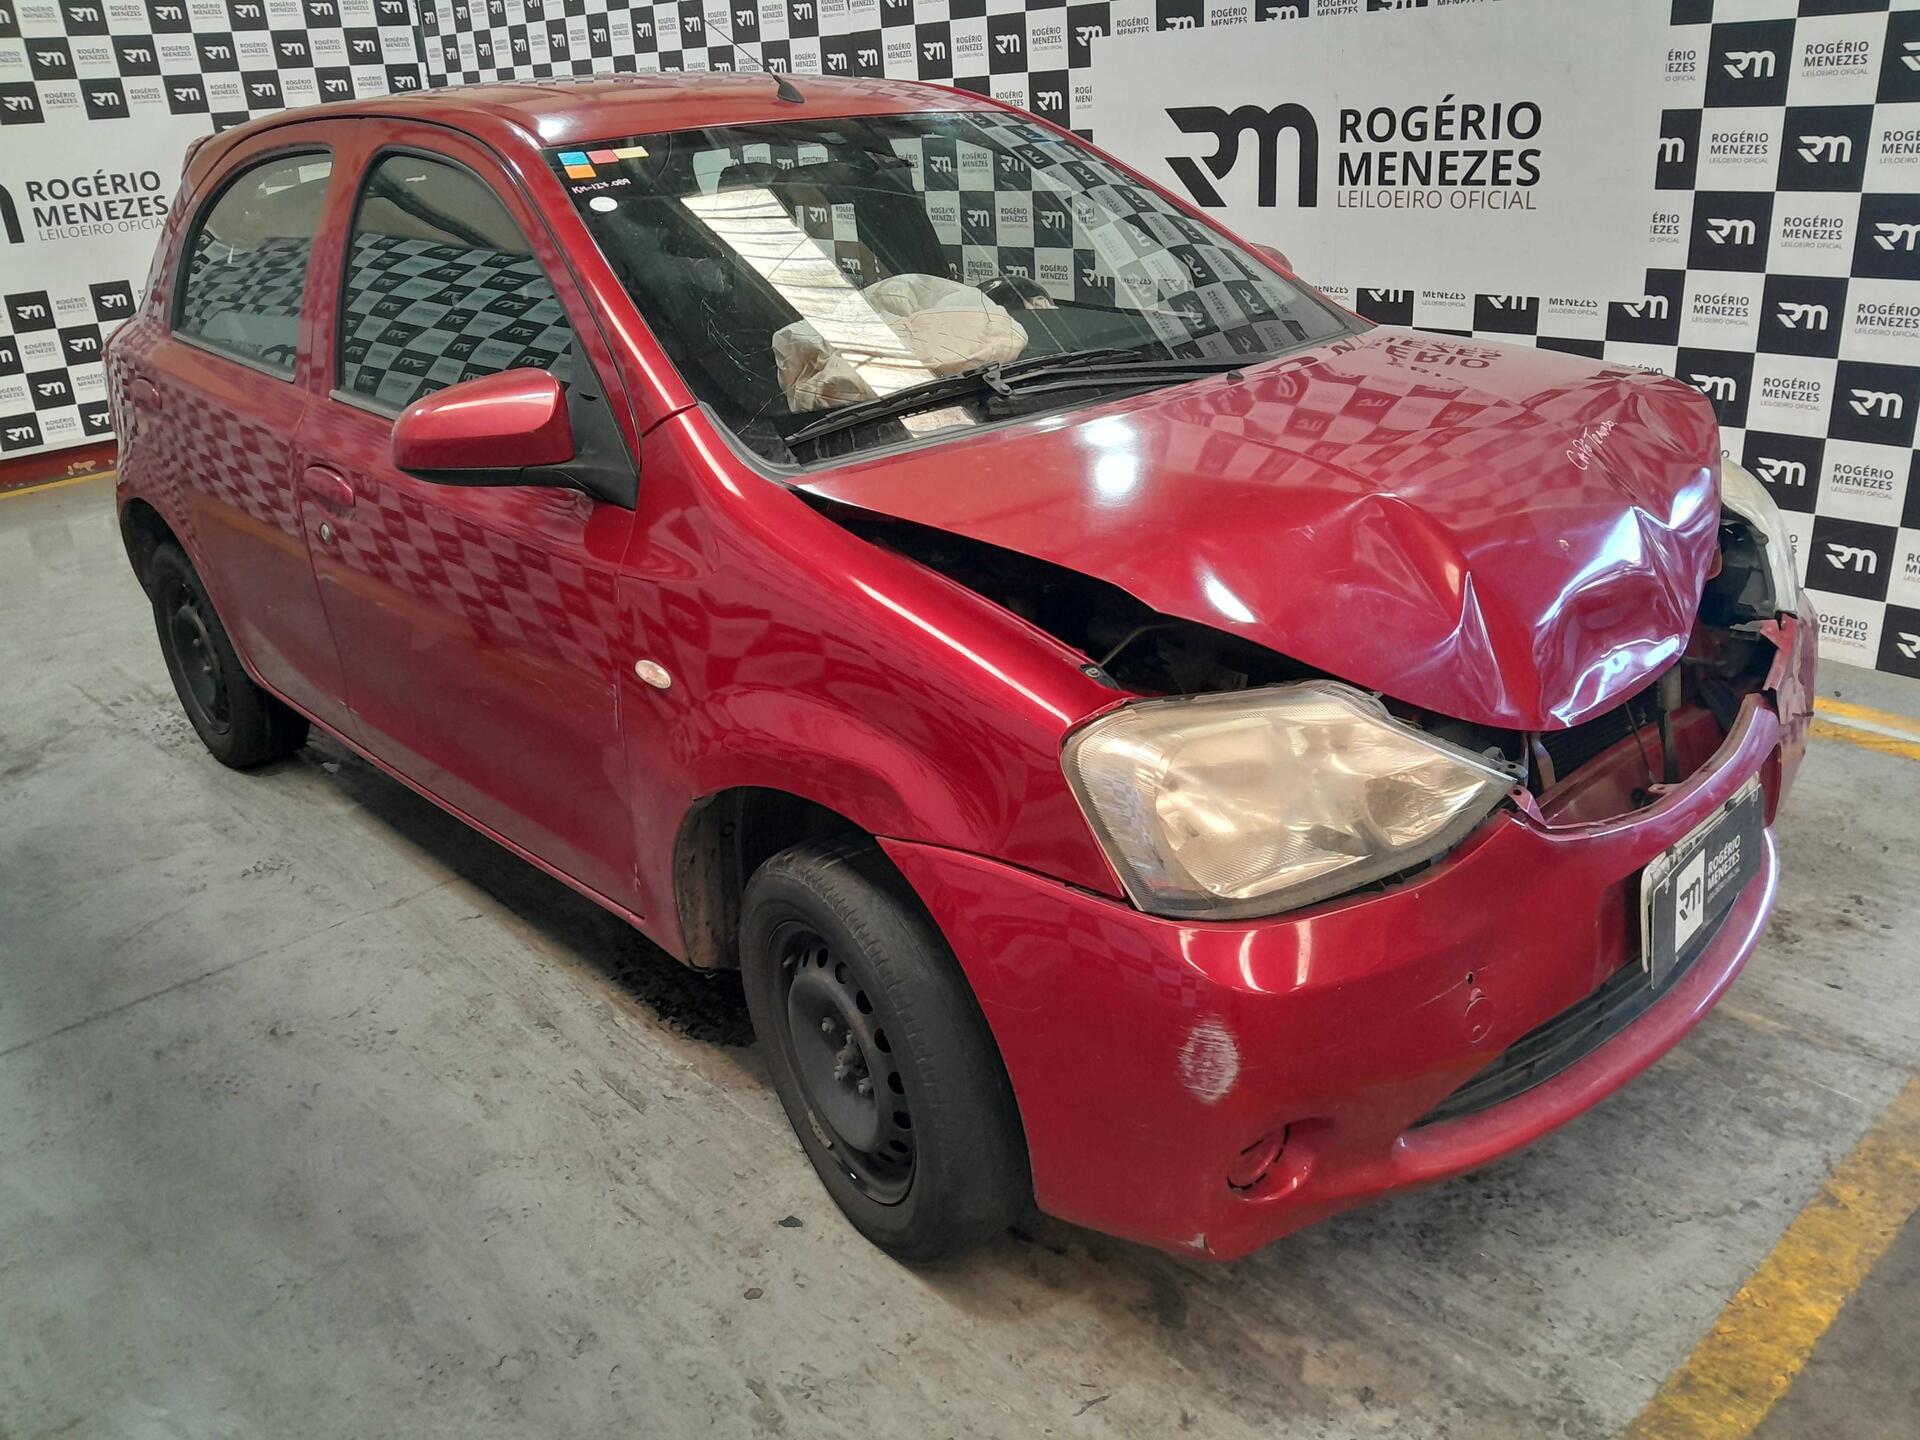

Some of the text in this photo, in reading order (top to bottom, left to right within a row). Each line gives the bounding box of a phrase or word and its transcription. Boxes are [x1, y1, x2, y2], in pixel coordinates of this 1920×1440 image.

[1211, 6, 1247, 18] ROGÉRIO
[1116, 16, 1149, 28] ROGÉRIO
[1032, 26, 1061, 37] ROGÉRIO
[887, 41, 911, 51] ROGÉRIO
[956, 34, 982, 44] ROGÉRIO
[1032, 35, 1062, 45] MENEZES
[887, 50, 912, 59] MENEZES
[956, 43, 983, 52] MENEZES
[1667, 48, 1696, 60] ÉRIO
[1805, 40, 1869, 55] ROGÉRIO
[1803, 54, 1868, 68] MENEZES
[996, 89, 1023, 99] ROGÉRIO
[1339, 93, 1542, 143] ROGÉRIO
[1711, 130, 1769, 143] ROGÉRIO
[1883, 128, 1920, 142] ROGÉ
[1710, 144, 1769, 155] MENEZES
[1881, 143, 1920, 154] MENE
[1338, 148, 1542, 187] MENEZES
[25, 169, 160, 202] ROGÉRIO
[1337, 190, 1537, 210] LEILOEIRO OFICIAL
[32, 195, 169, 228] MENEZES
[1652, 211, 1680, 224] ÉRIO
[1783, 214, 1844, 229] ROGÉRIO
[38, 223, 114, 241] LEILOEIRO
[1782, 229, 1843, 241] MENEZES
[1040, 264, 1068, 273] ROGÉRIO
[1040, 272, 1068, 280] MENEZES
[1694, 291, 1750, 306] ROGÉRIO
[1693, 305, 1749, 318] MENEZES
[1857, 302, 1920, 317] ROGÉRIO
[1856, 315, 1920, 329] MENEZES
[1763, 376, 1821, 392] ROGÉRIO
[1762, 389, 1820, 403] MENEZES
[1834, 463, 1894, 480] ROGÉRIO
[1832, 475, 1892, 491] MENEZES
[1818, 613, 1868, 631] OGÉRIO
[1708, 834, 1740, 877] ROGÉRIO
